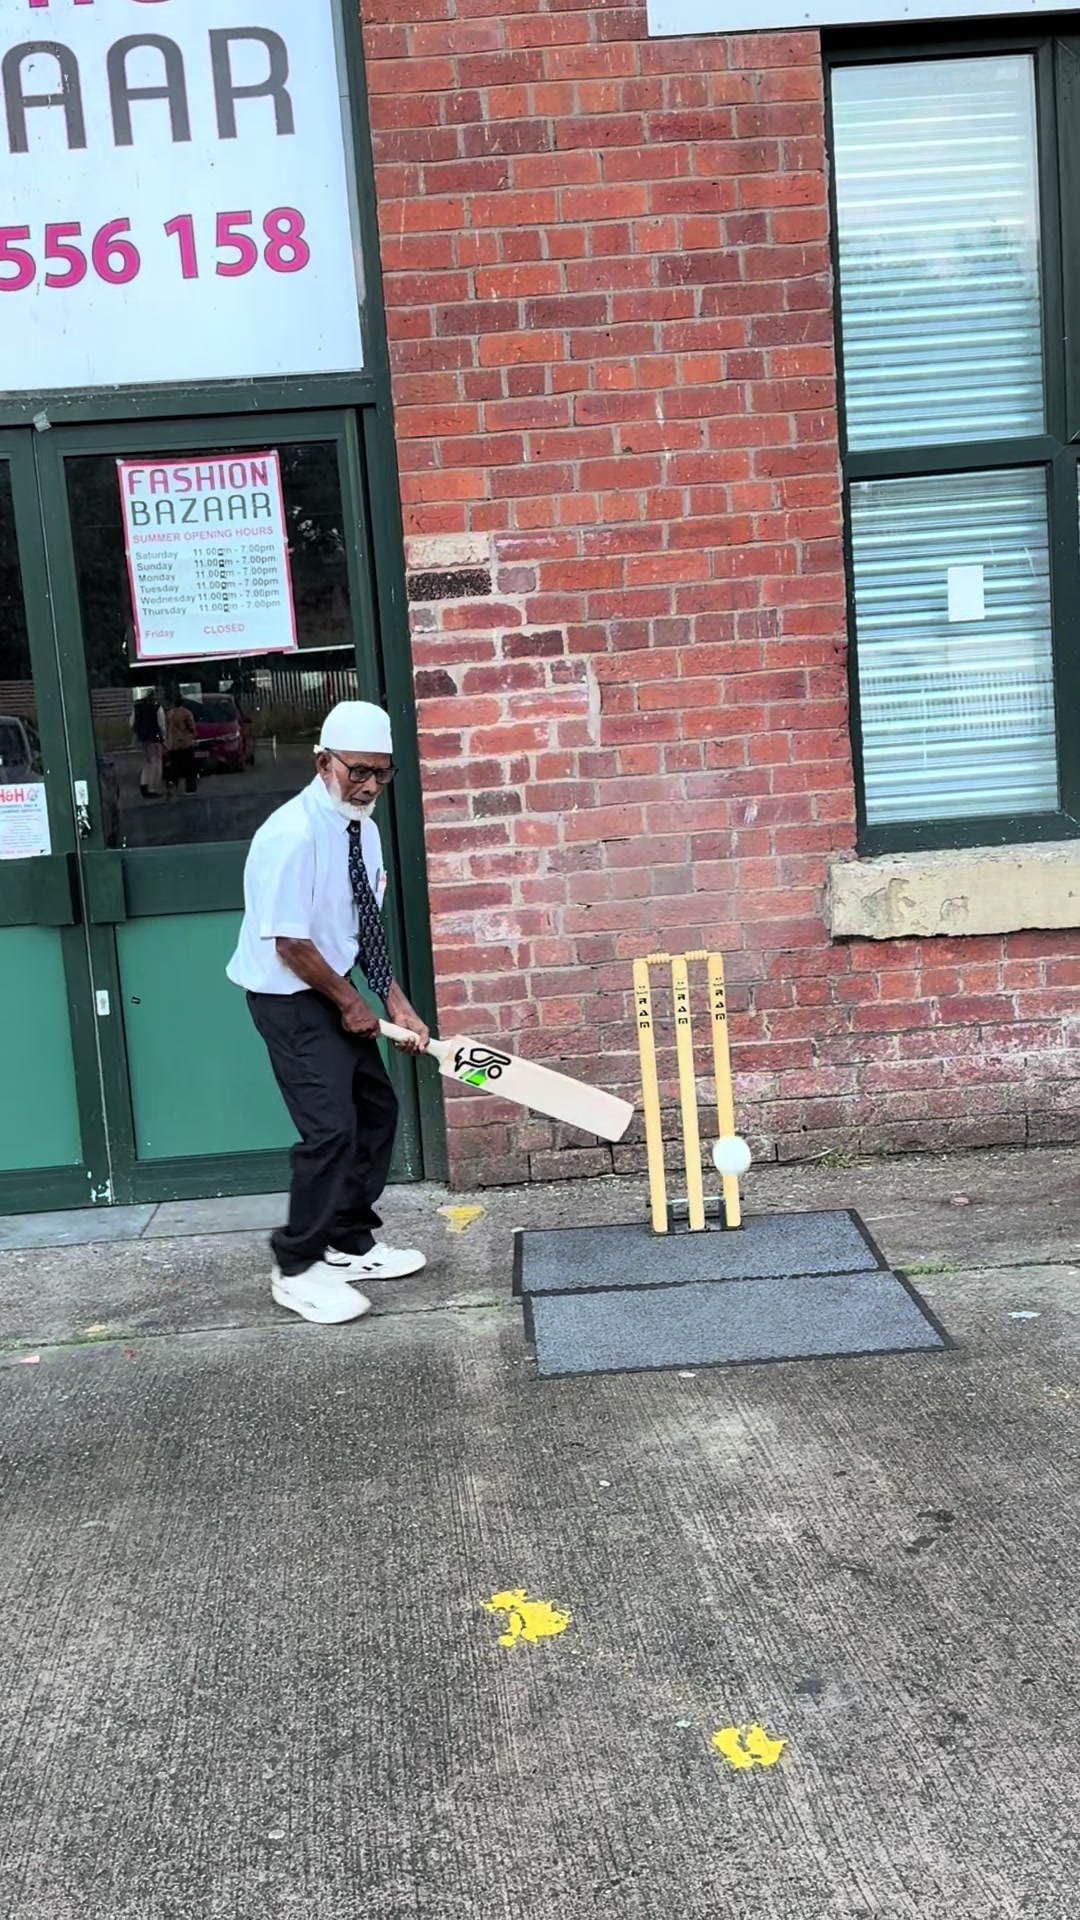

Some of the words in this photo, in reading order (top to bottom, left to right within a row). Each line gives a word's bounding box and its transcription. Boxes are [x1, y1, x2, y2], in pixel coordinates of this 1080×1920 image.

[0, 217, 141, 292] 556
[163, 206, 311, 280] 158
[127, 460, 269, 496] FASHION
[130, 491, 273, 527] BAZAAR
[133, 533, 181, 544] SUMMER
[184, 529, 233, 541] OPENING
[235, 525, 274, 537] HOURS
[135, 550, 179, 561] Saturday
[136, 562, 174, 572] Sunday
[138, 574, 176, 583] Monday
[140, 584, 180, 595] Tuesday
[141, 594, 196, 606] Wednesday
[142, 606, 187, 617] Thursday
[145, 628, 175, 640] Friday
[203, 623, 245, 635] CLOSED
